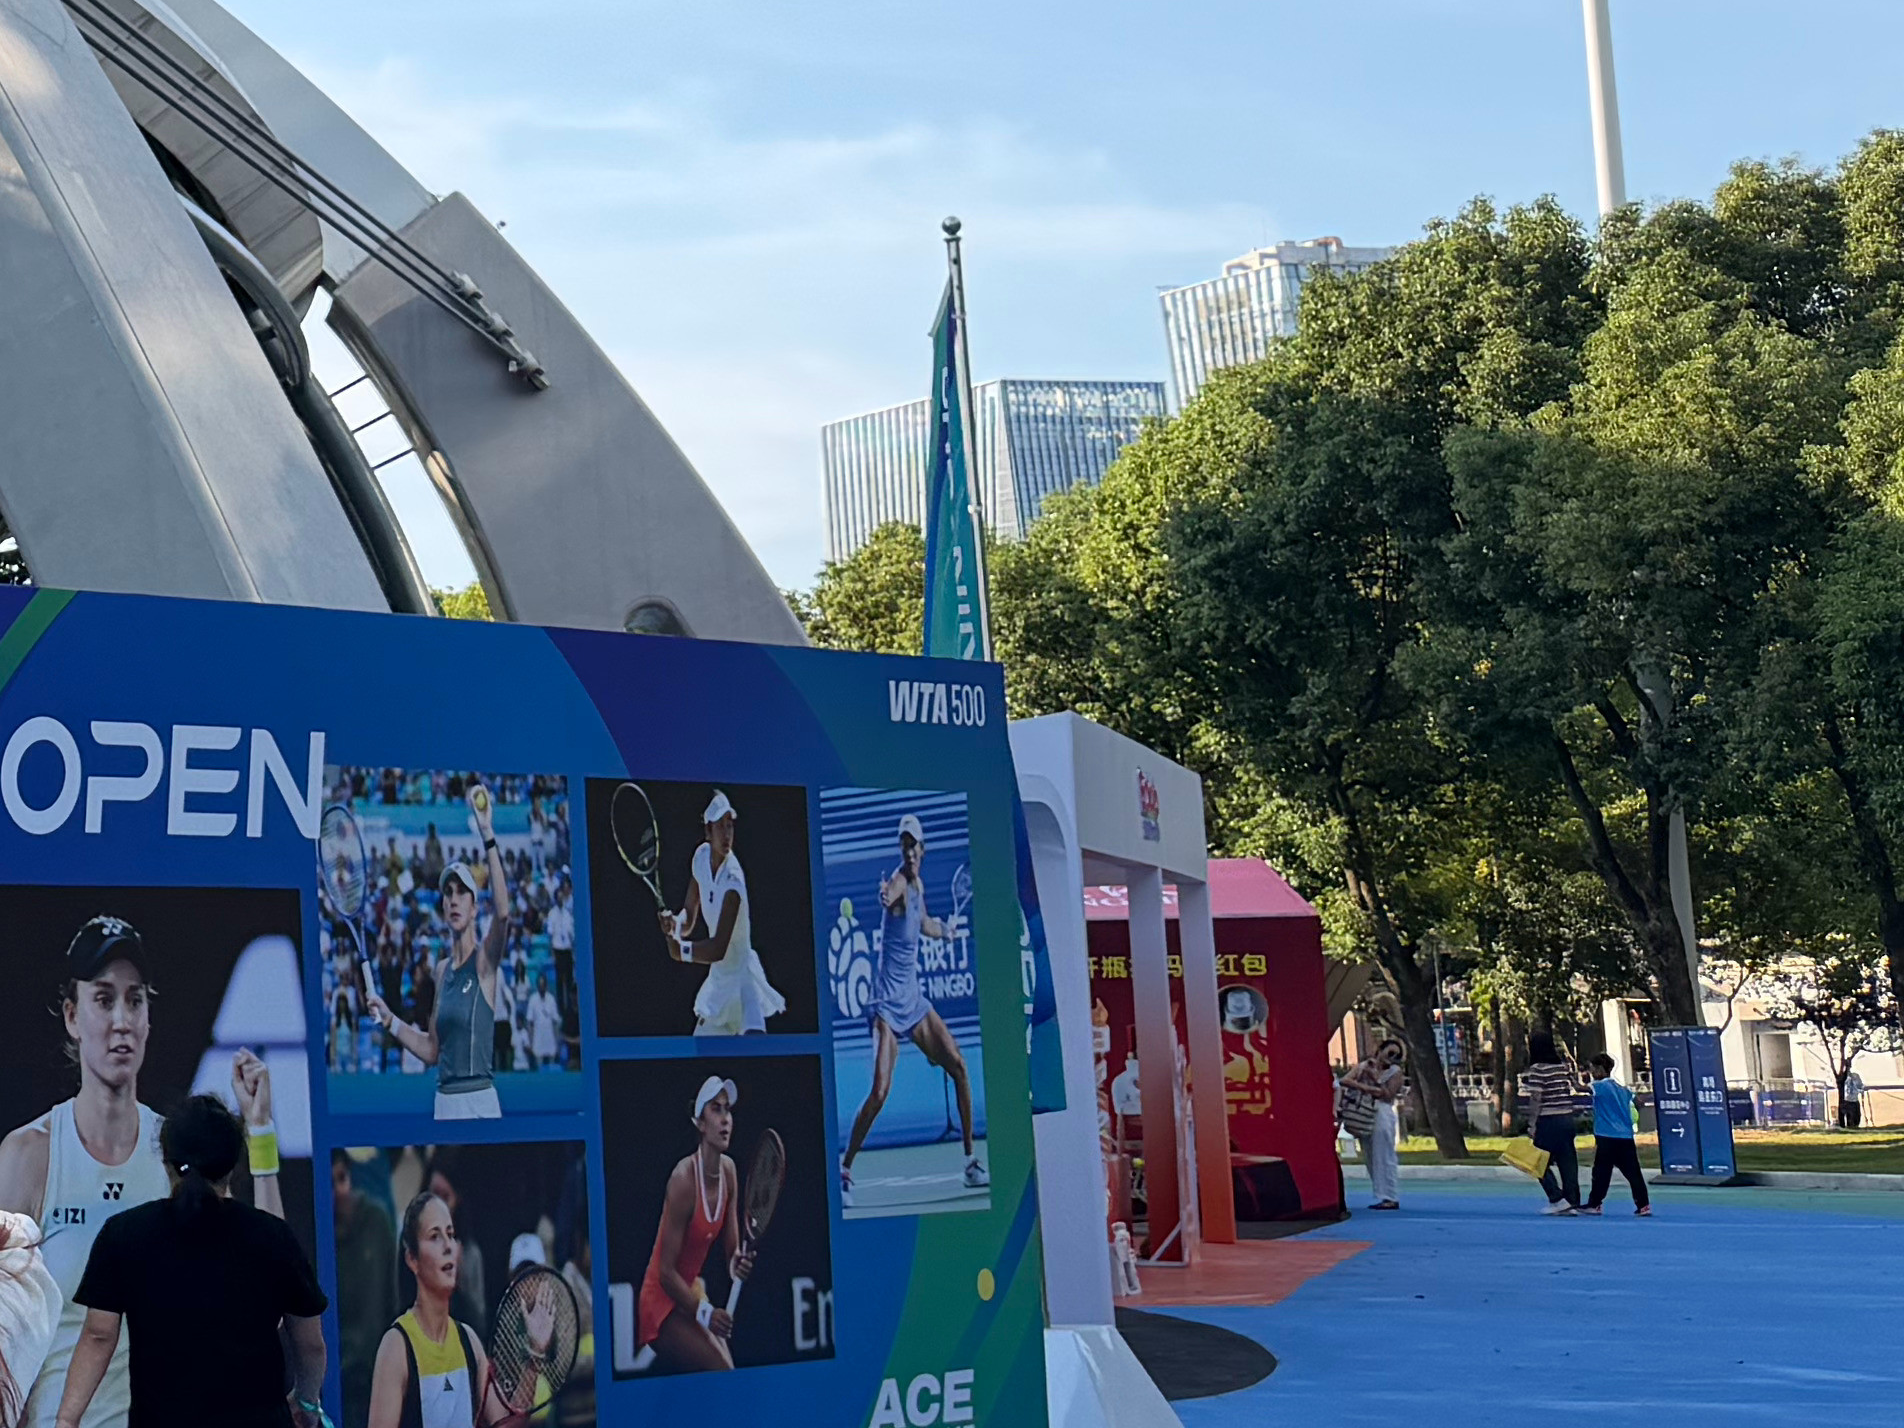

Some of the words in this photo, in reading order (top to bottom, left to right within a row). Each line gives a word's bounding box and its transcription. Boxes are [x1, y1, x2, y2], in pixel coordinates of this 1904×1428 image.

[888, 679, 949, 725] WTA
[951, 683, 987, 728] 500
[0, 714, 327, 841] OPEN
